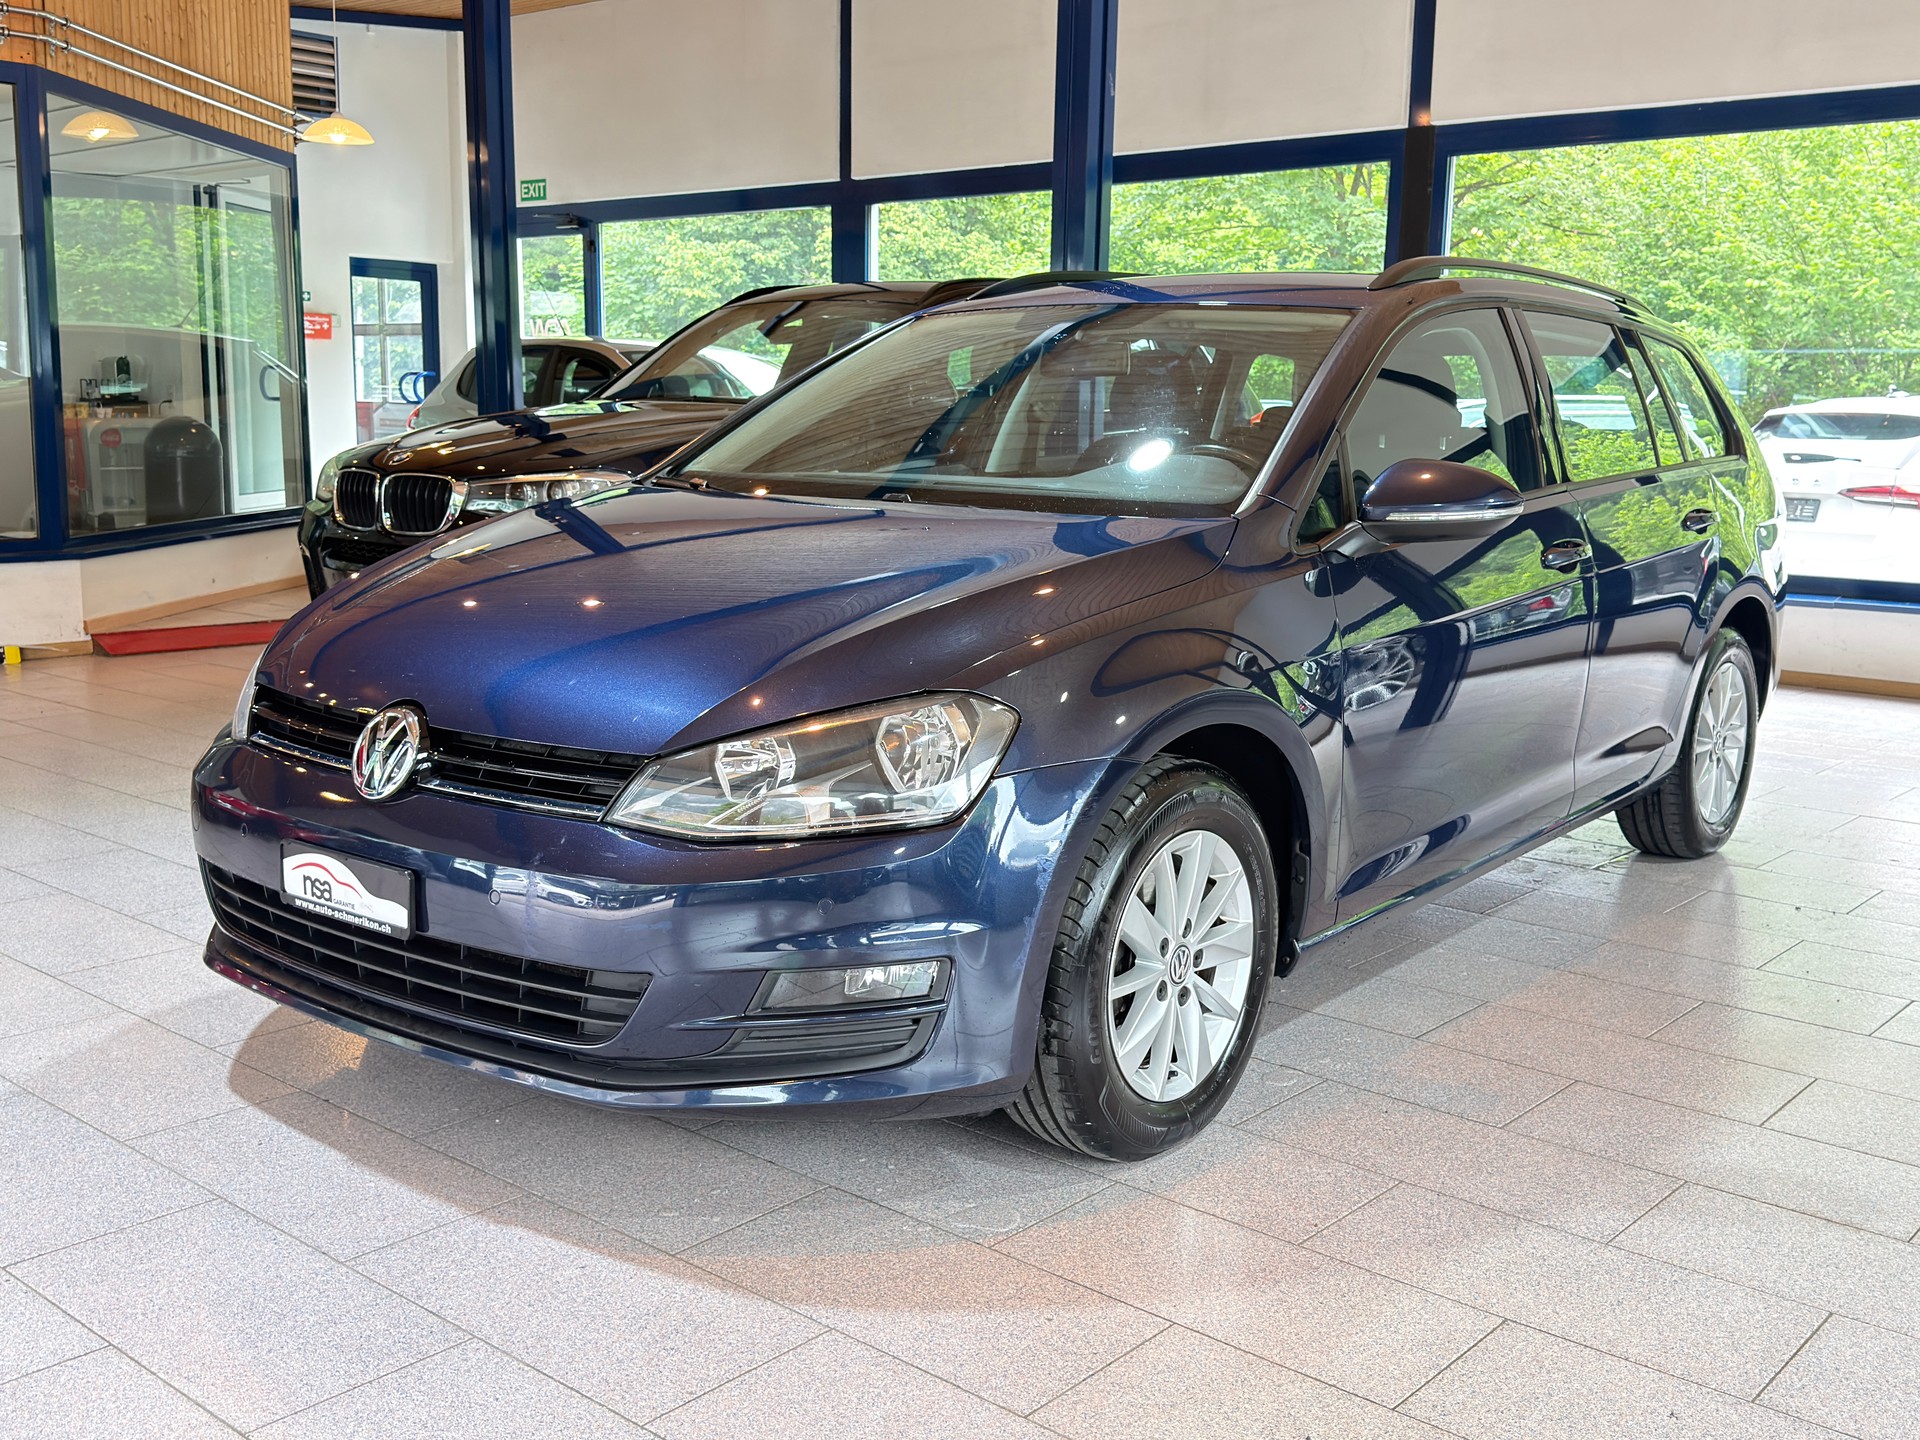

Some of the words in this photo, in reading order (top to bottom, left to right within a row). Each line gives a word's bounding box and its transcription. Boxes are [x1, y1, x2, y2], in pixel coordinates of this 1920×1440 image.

[521, 182, 545, 198] EXIT
[353, 708, 419, 799] VW
[303, 874, 333, 903] nsa
[333, 898, 356, 911] GARANTIE
[295, 898, 392, 934] www.auto-schmerikon.ch
[1170, 946, 1191, 983] VW
